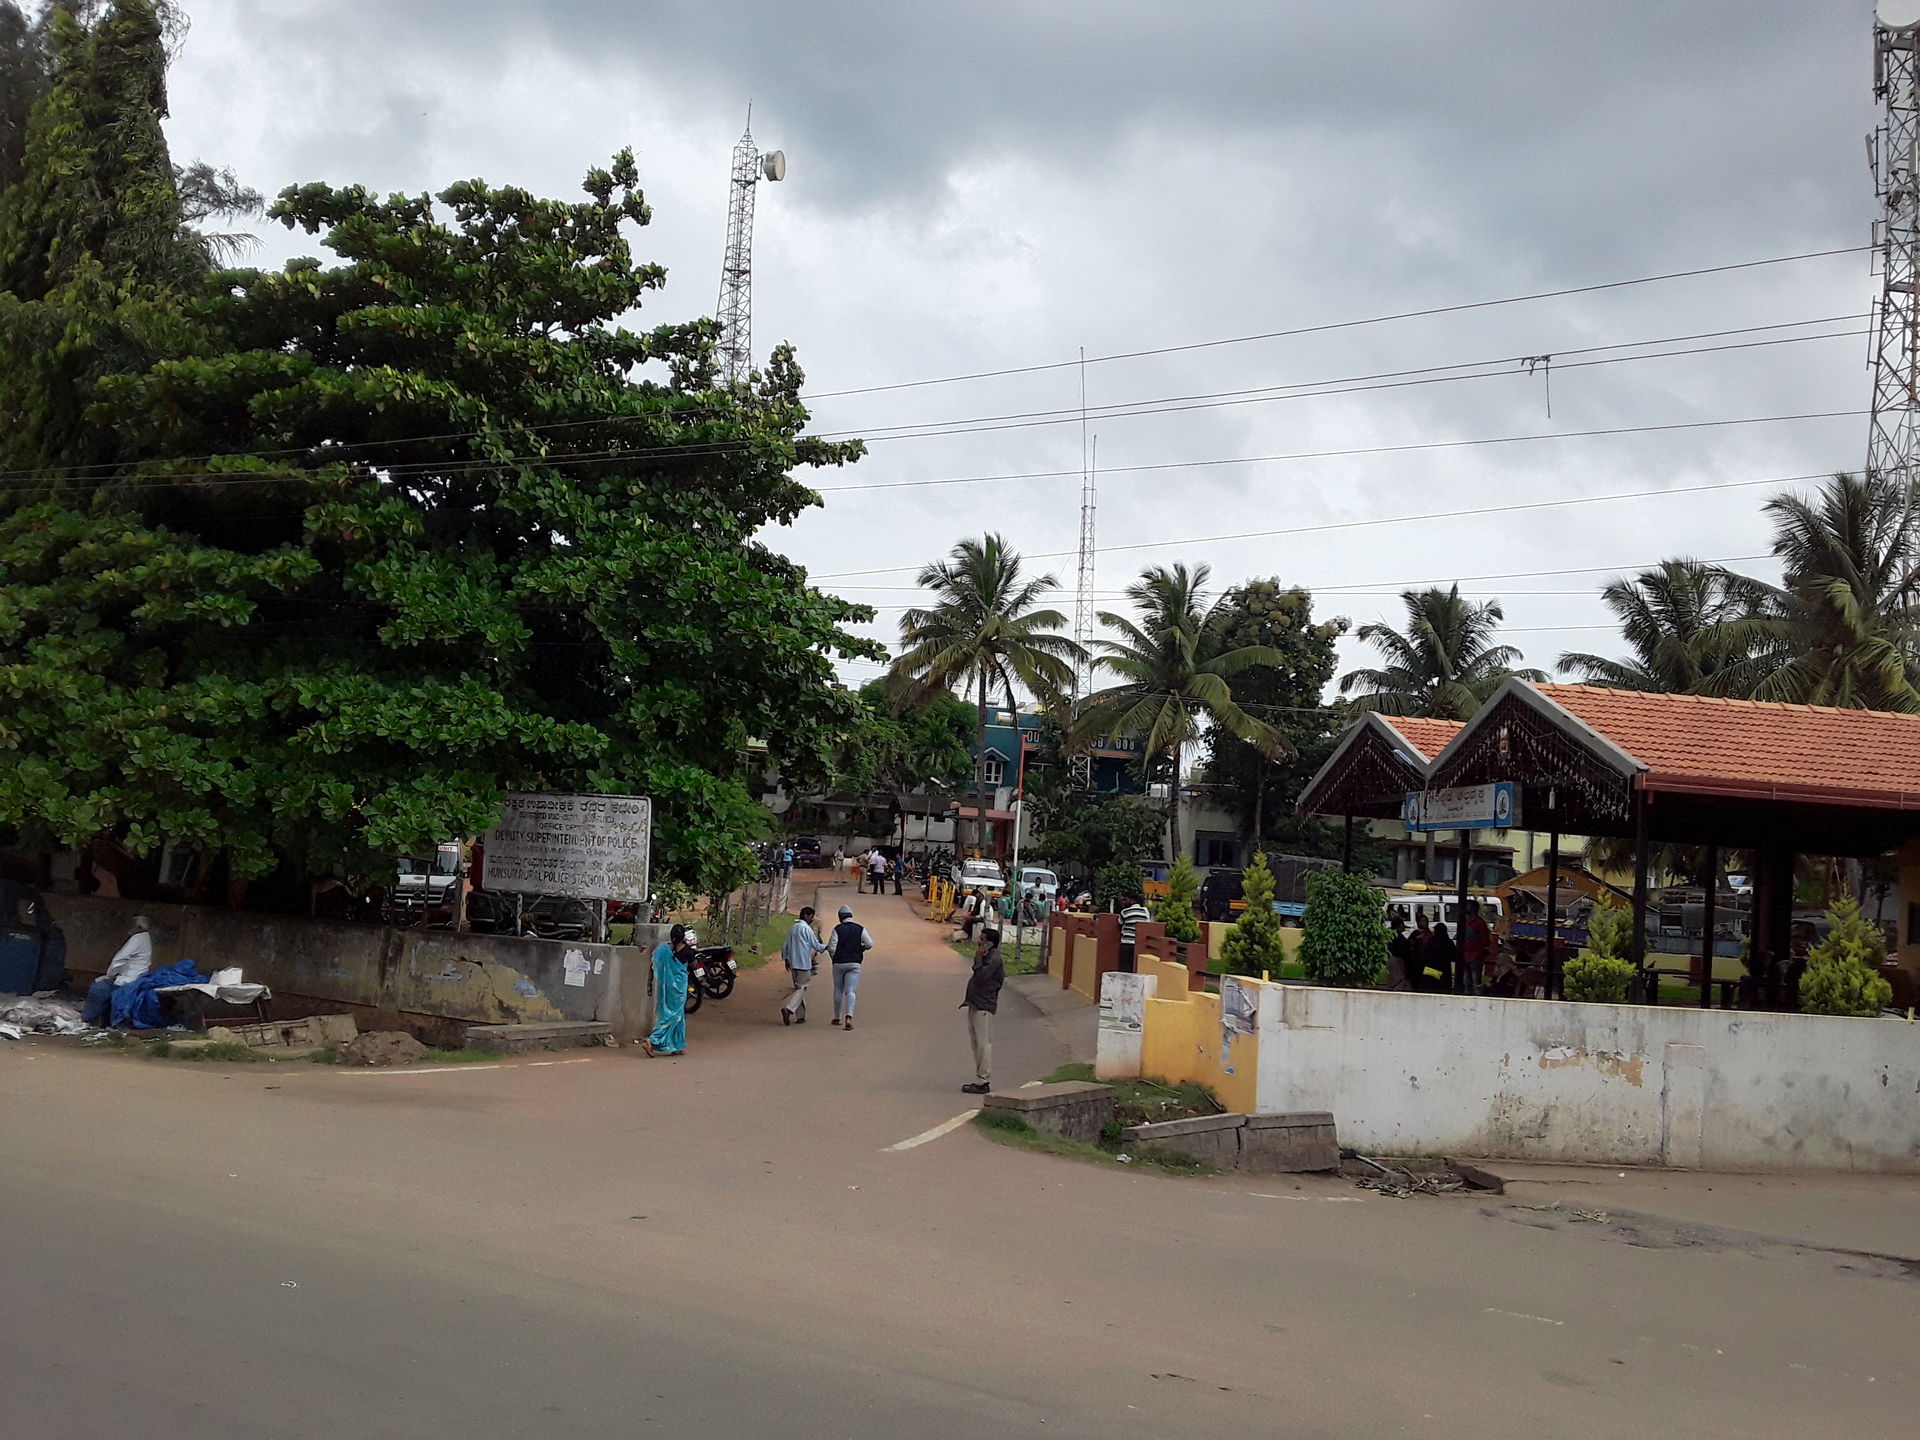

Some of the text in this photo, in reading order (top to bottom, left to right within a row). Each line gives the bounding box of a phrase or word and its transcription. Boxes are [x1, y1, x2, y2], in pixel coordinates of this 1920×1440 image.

[539, 822, 563, 831] OFFICE
[495, 830, 525, 841] DEPUTY
[597, 836, 607, 847] OF
[608, 837, 637, 848] POLICE
[544, 871, 569, 883] POLICE
